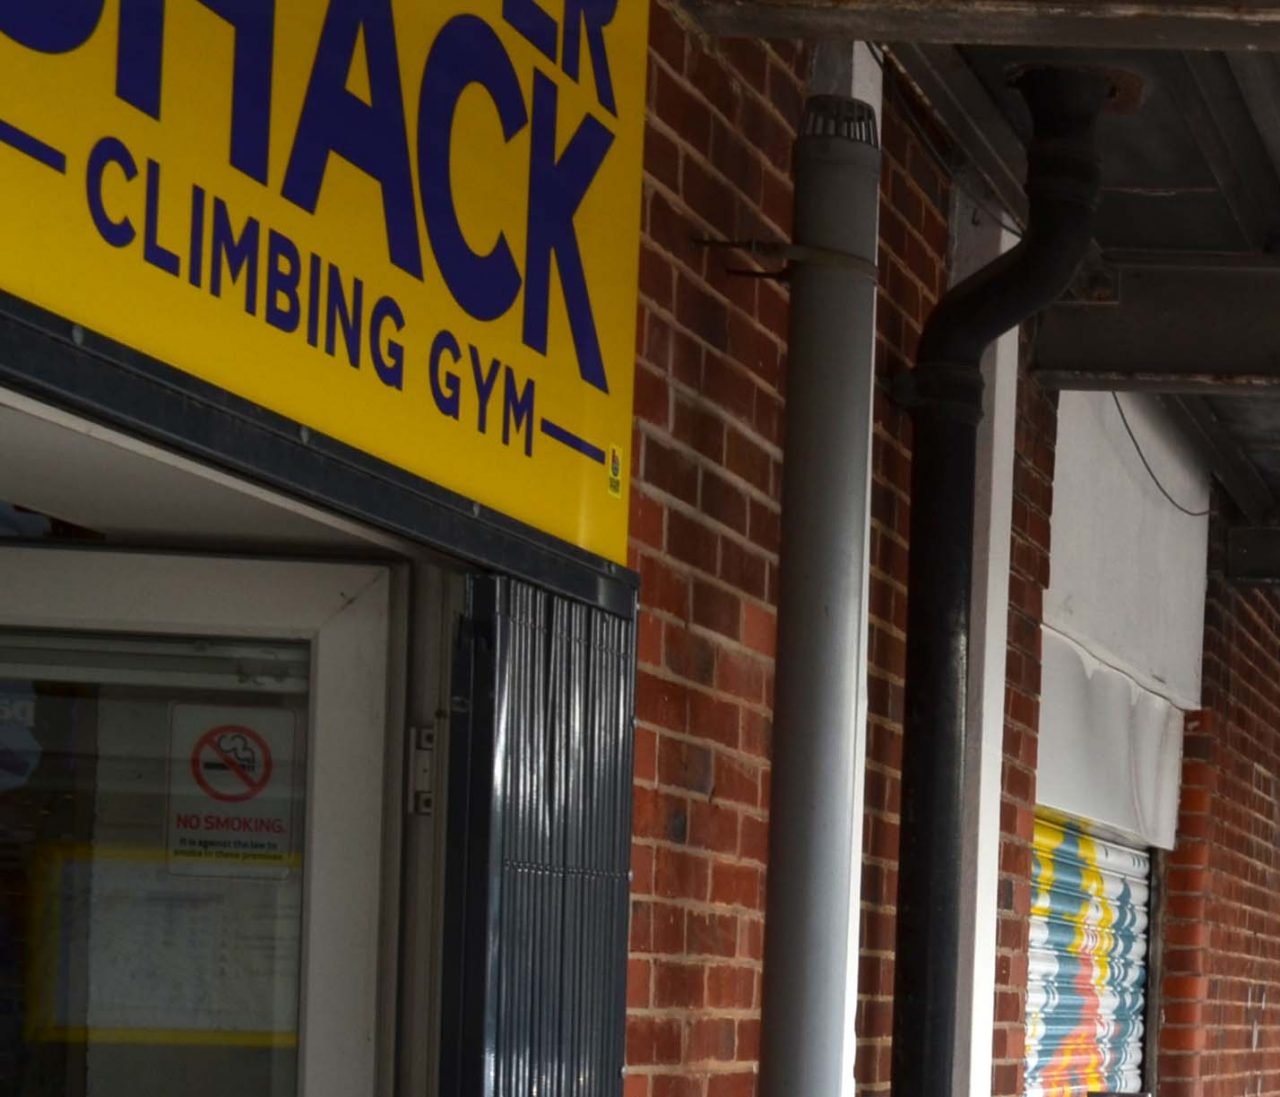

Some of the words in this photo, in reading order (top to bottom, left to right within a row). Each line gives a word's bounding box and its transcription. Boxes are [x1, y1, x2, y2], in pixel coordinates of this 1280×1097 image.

[0, 0, 615, 395] HACK
[86, 136, 406, 392] CLIMBING
[427, 329, 536, 458] GYM
[175, 813, 201, 830] NO
